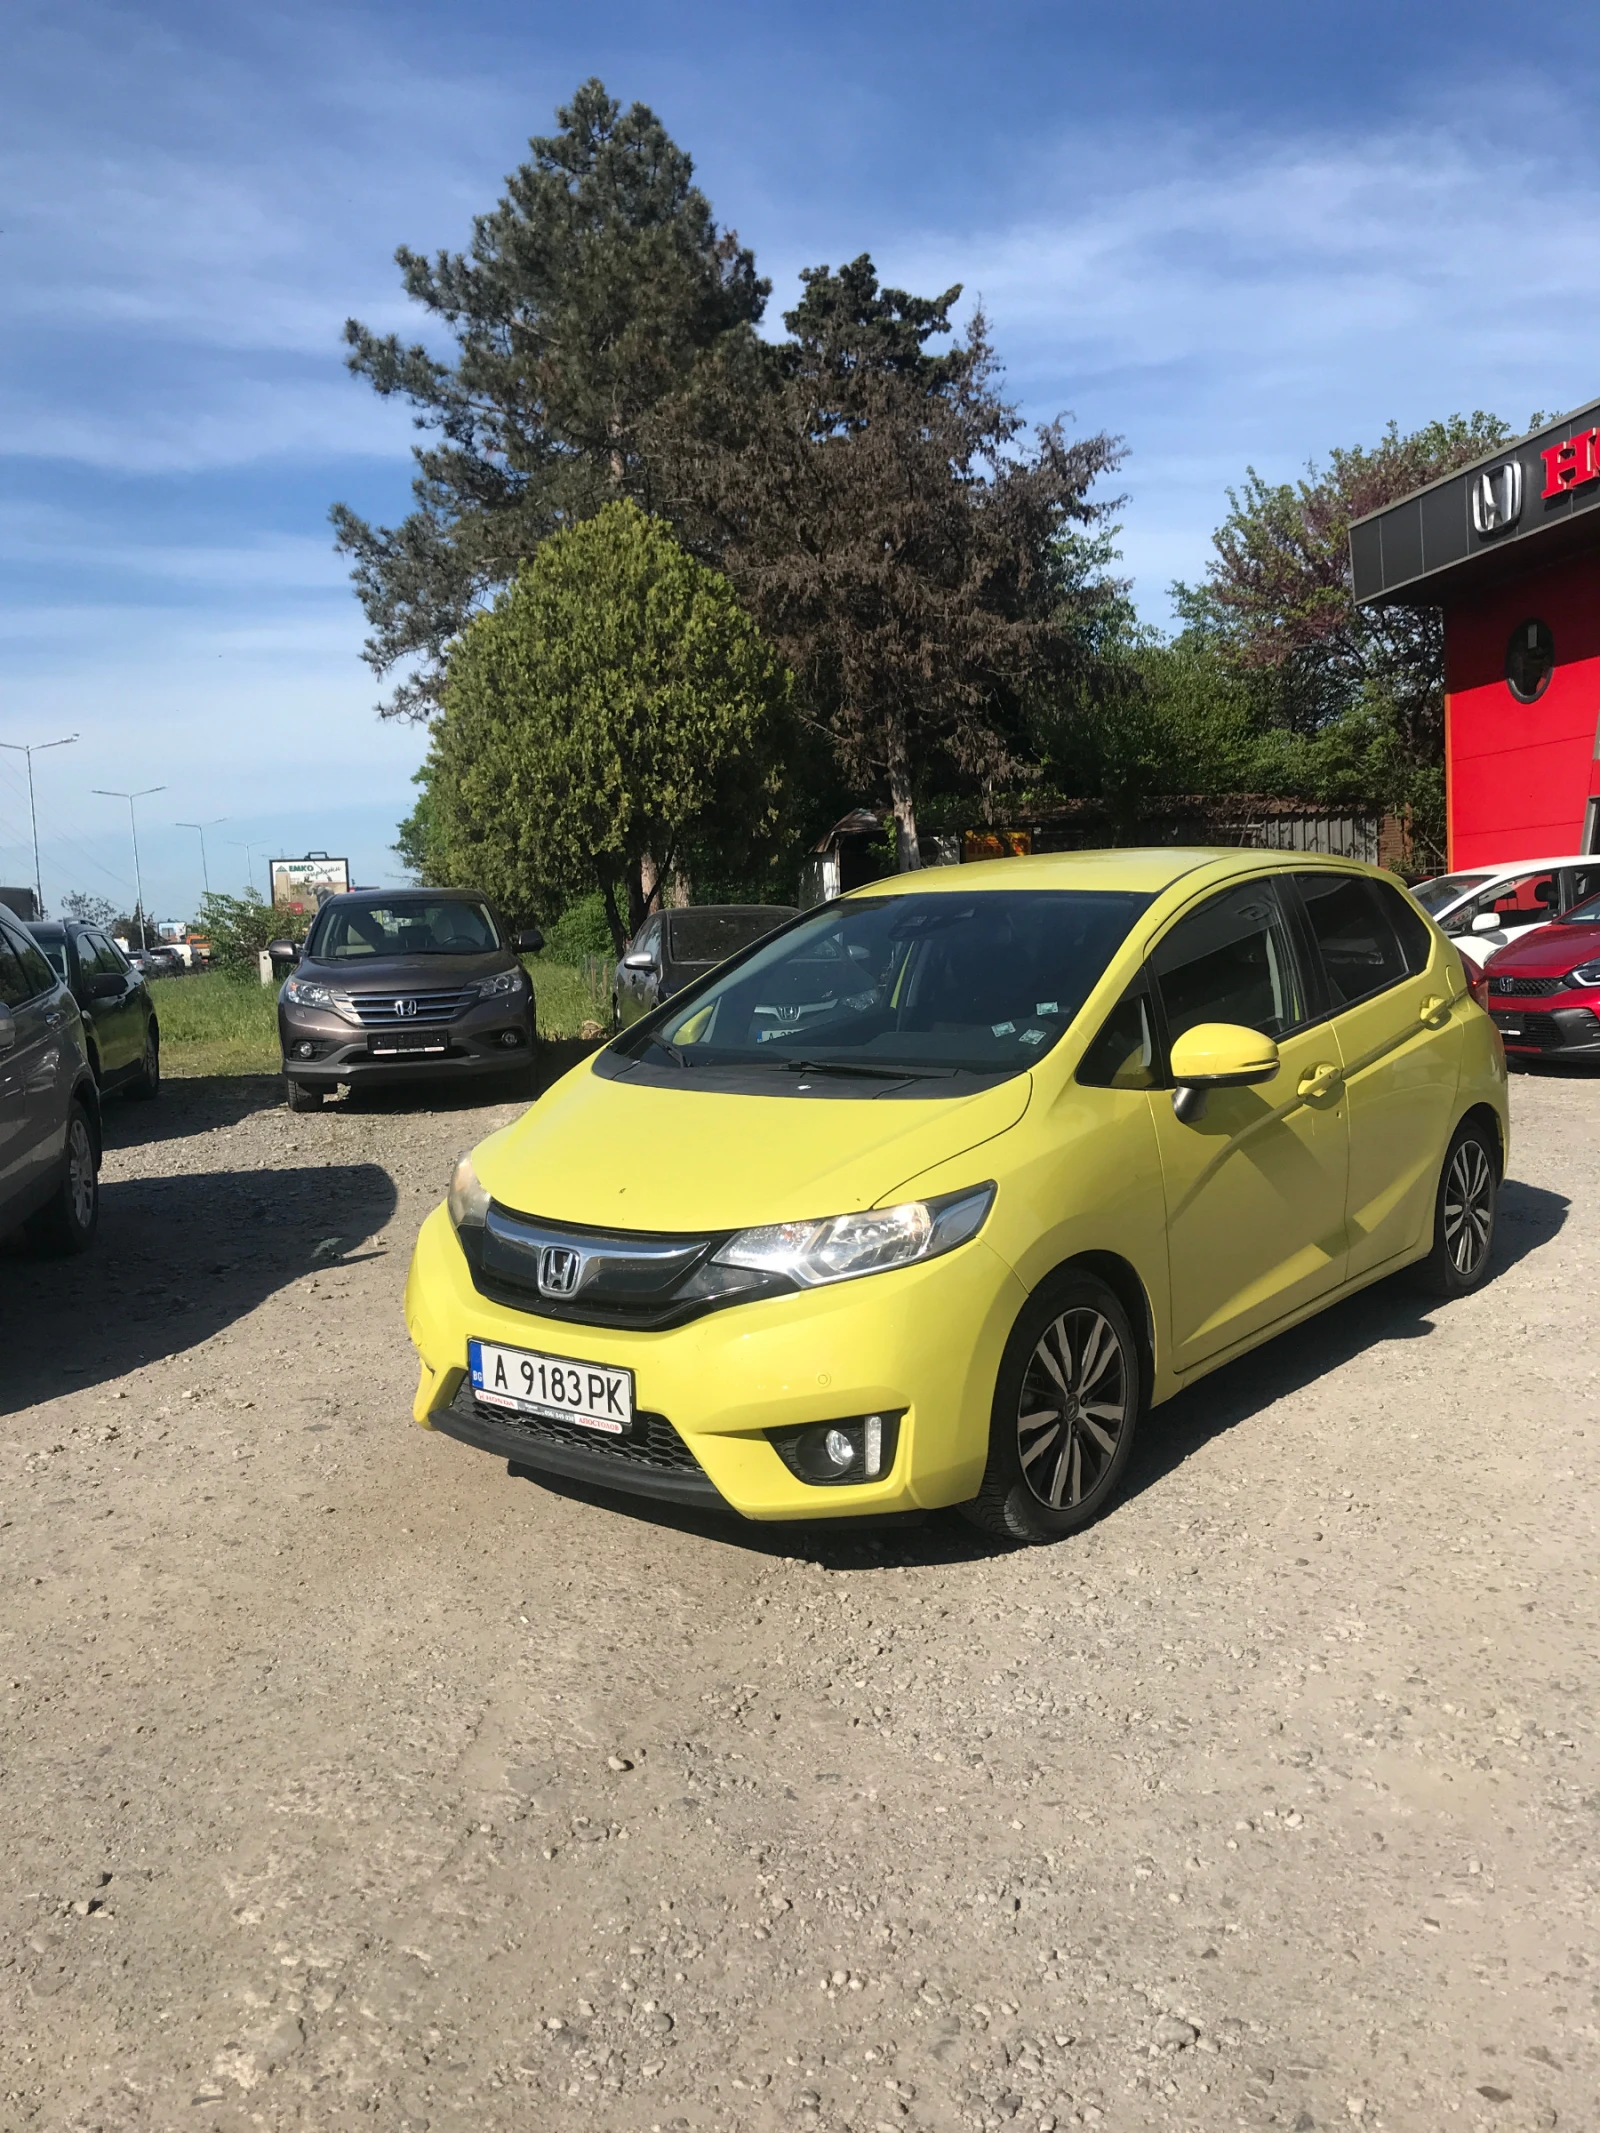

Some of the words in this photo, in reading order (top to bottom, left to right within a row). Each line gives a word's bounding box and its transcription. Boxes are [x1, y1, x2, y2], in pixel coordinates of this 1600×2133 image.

[1540, 427, 1600, 499] H
[472, 1370, 483, 1382] BG
[494, 1354, 508, 1390] A
[486, 1394, 515, 1407] HONDA
